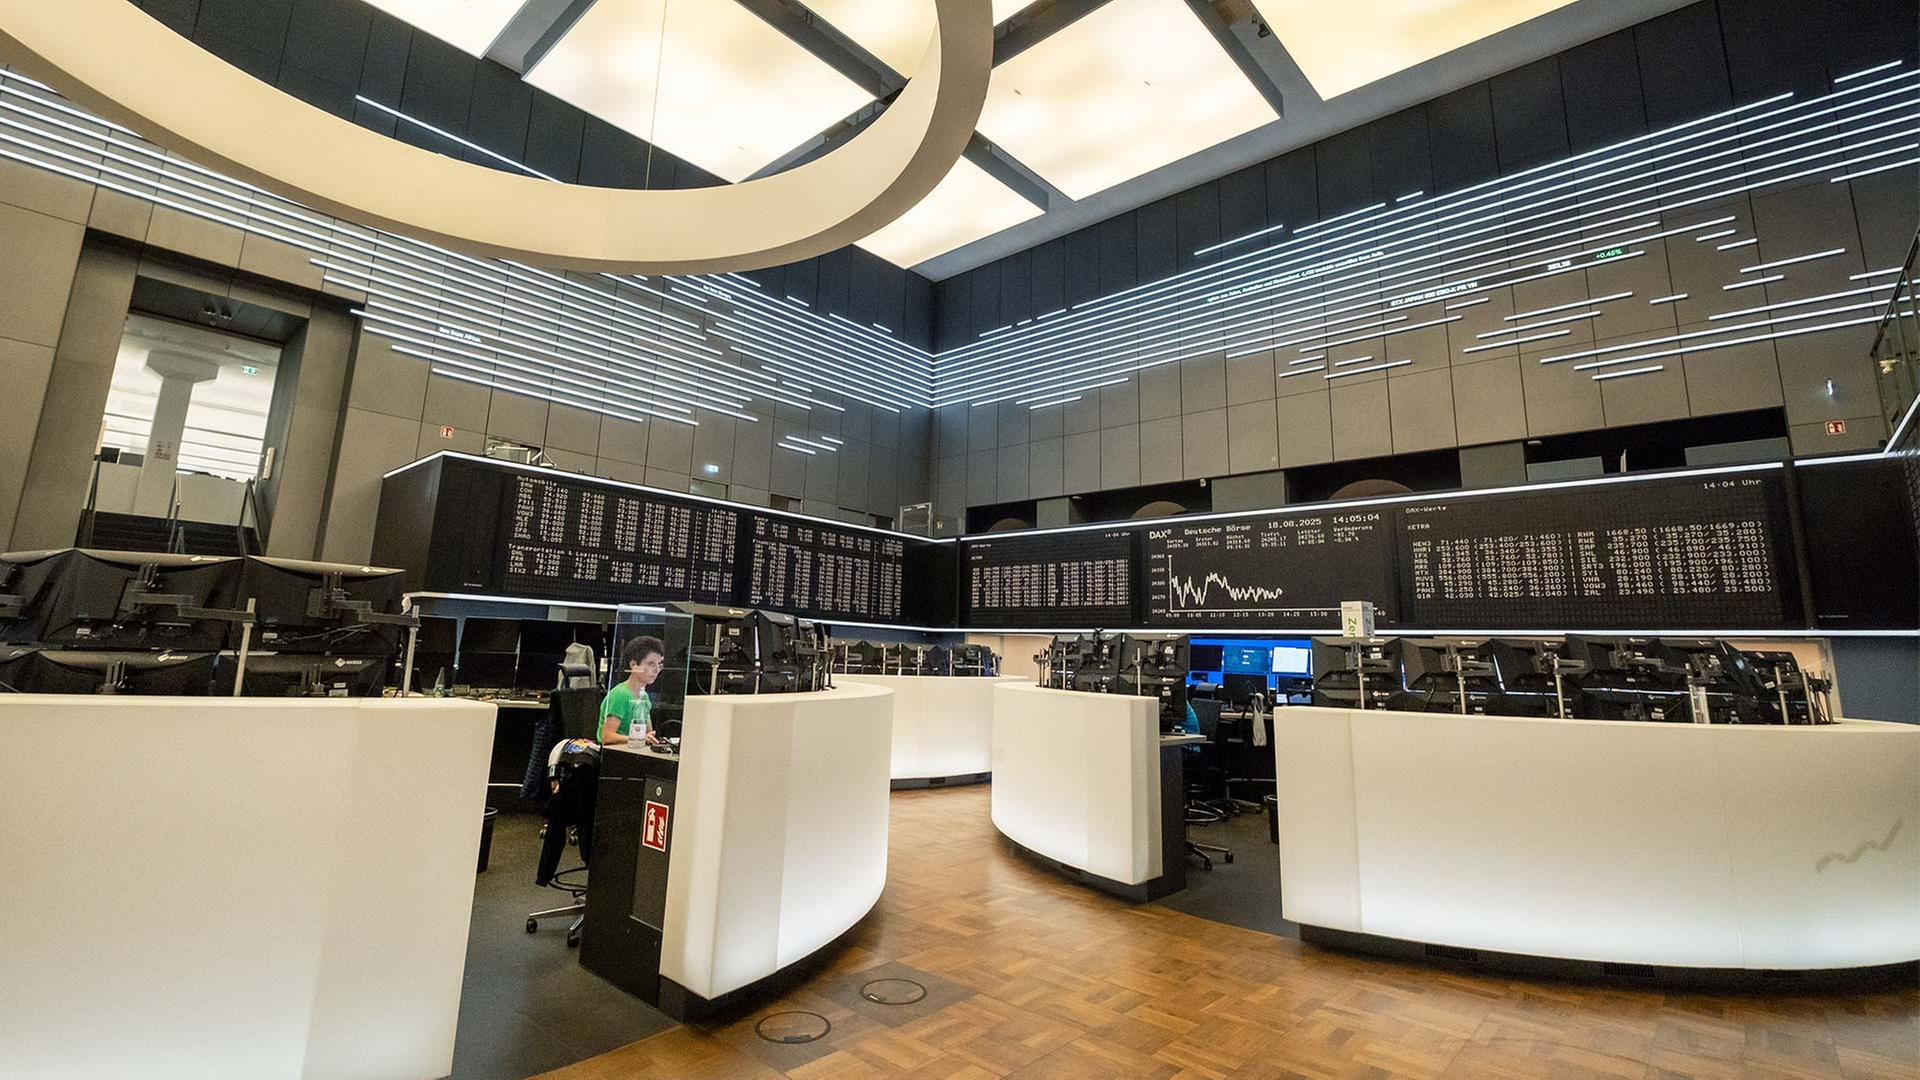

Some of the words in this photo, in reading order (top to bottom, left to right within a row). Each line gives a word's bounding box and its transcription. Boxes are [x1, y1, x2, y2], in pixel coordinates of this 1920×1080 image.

[1406, 506, 1447, 514] DAX-Werte
[1268, 518, 1321, 529] 18.08.2025
[1333, 514, 1379, 524] 14:05:04
[1184, 527, 1221, 535] Deutsche
[1226, 524, 1251, 532] Börse
[1606, 528, 1646, 536] 1668,50
[1607, 541, 1648, 549] 235,700
